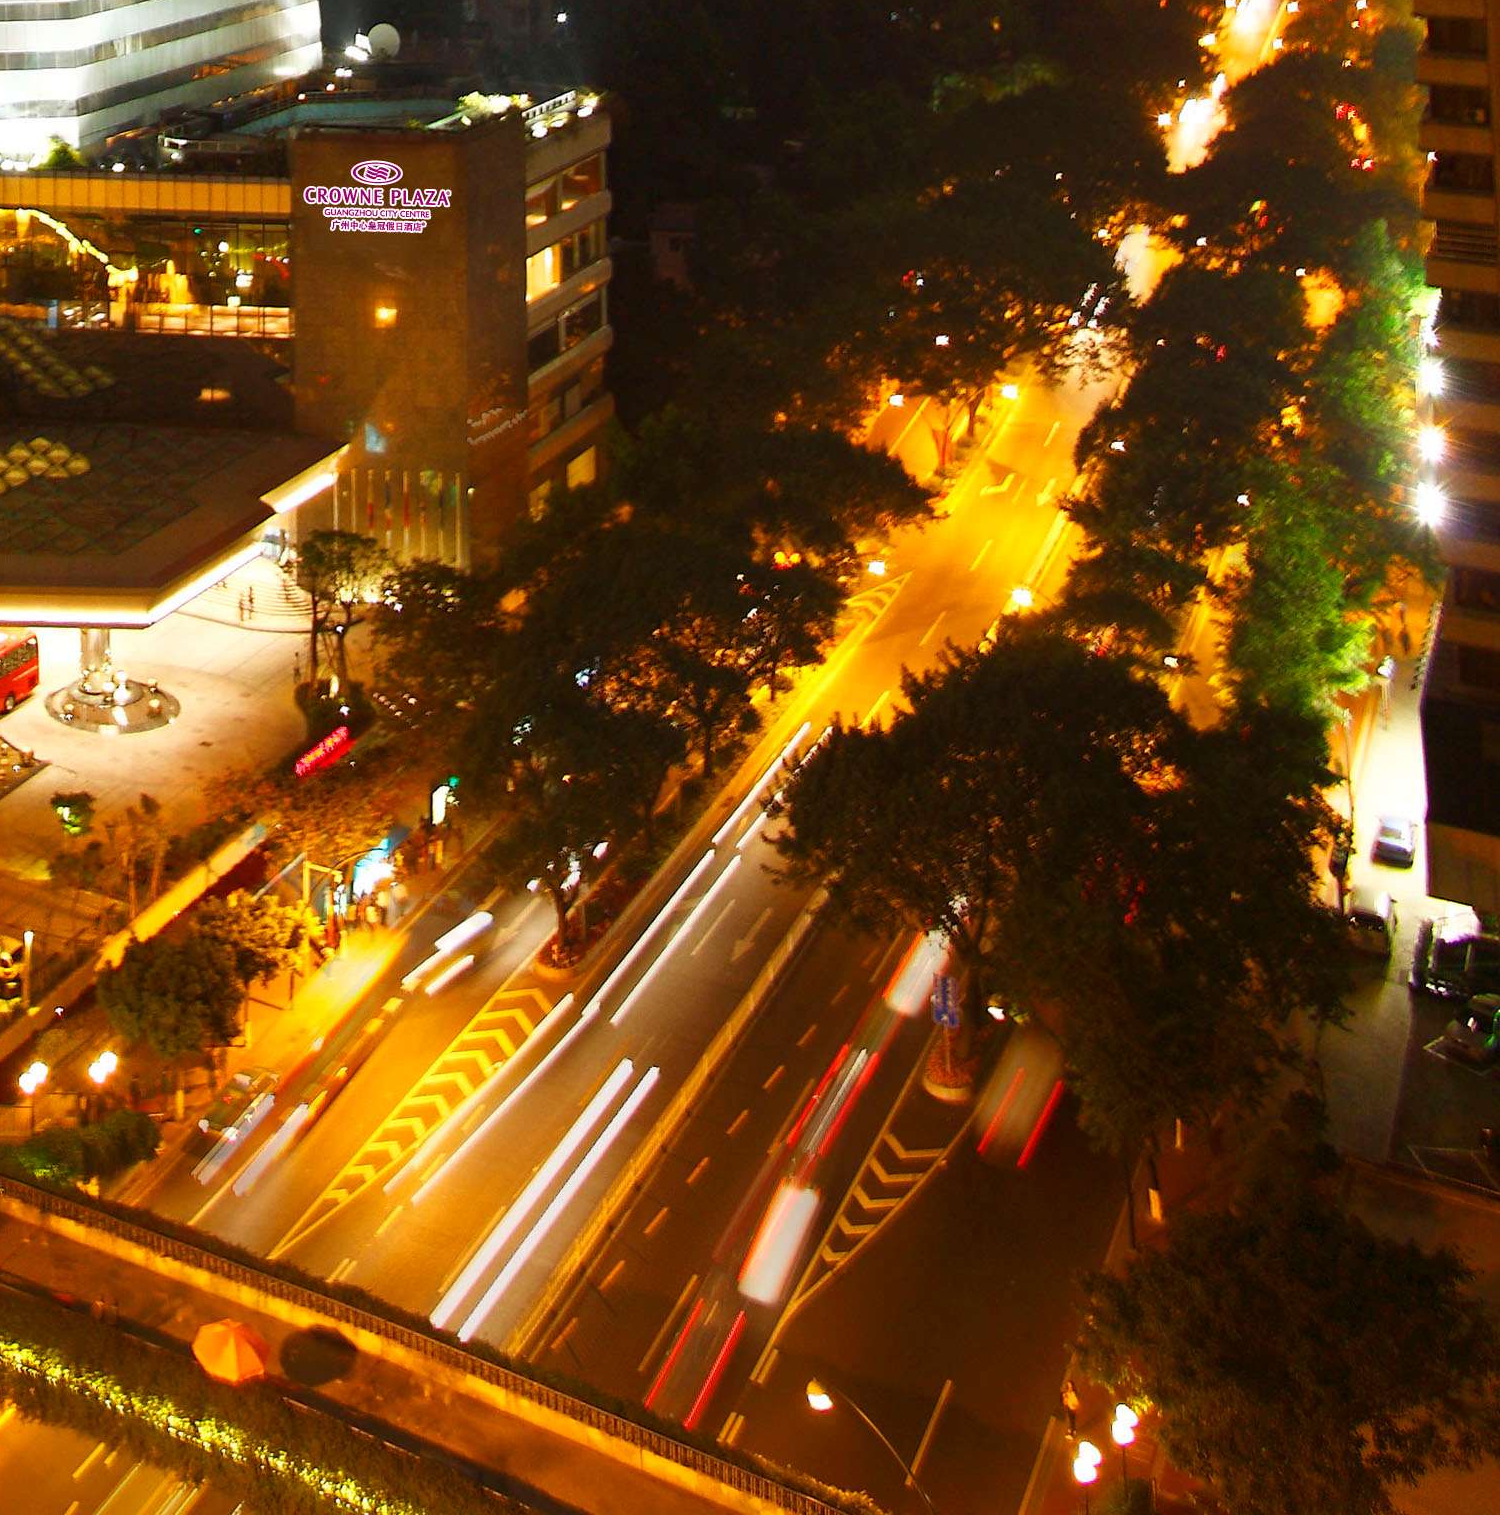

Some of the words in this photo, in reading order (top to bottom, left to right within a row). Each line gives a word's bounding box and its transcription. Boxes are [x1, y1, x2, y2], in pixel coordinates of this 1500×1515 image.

[304, 186, 385, 206] CROWNE
[323, 207, 379, 218] GUANGZHOU
[379, 209, 399, 219] CITY
[399, 209, 431, 219] CENTRE
